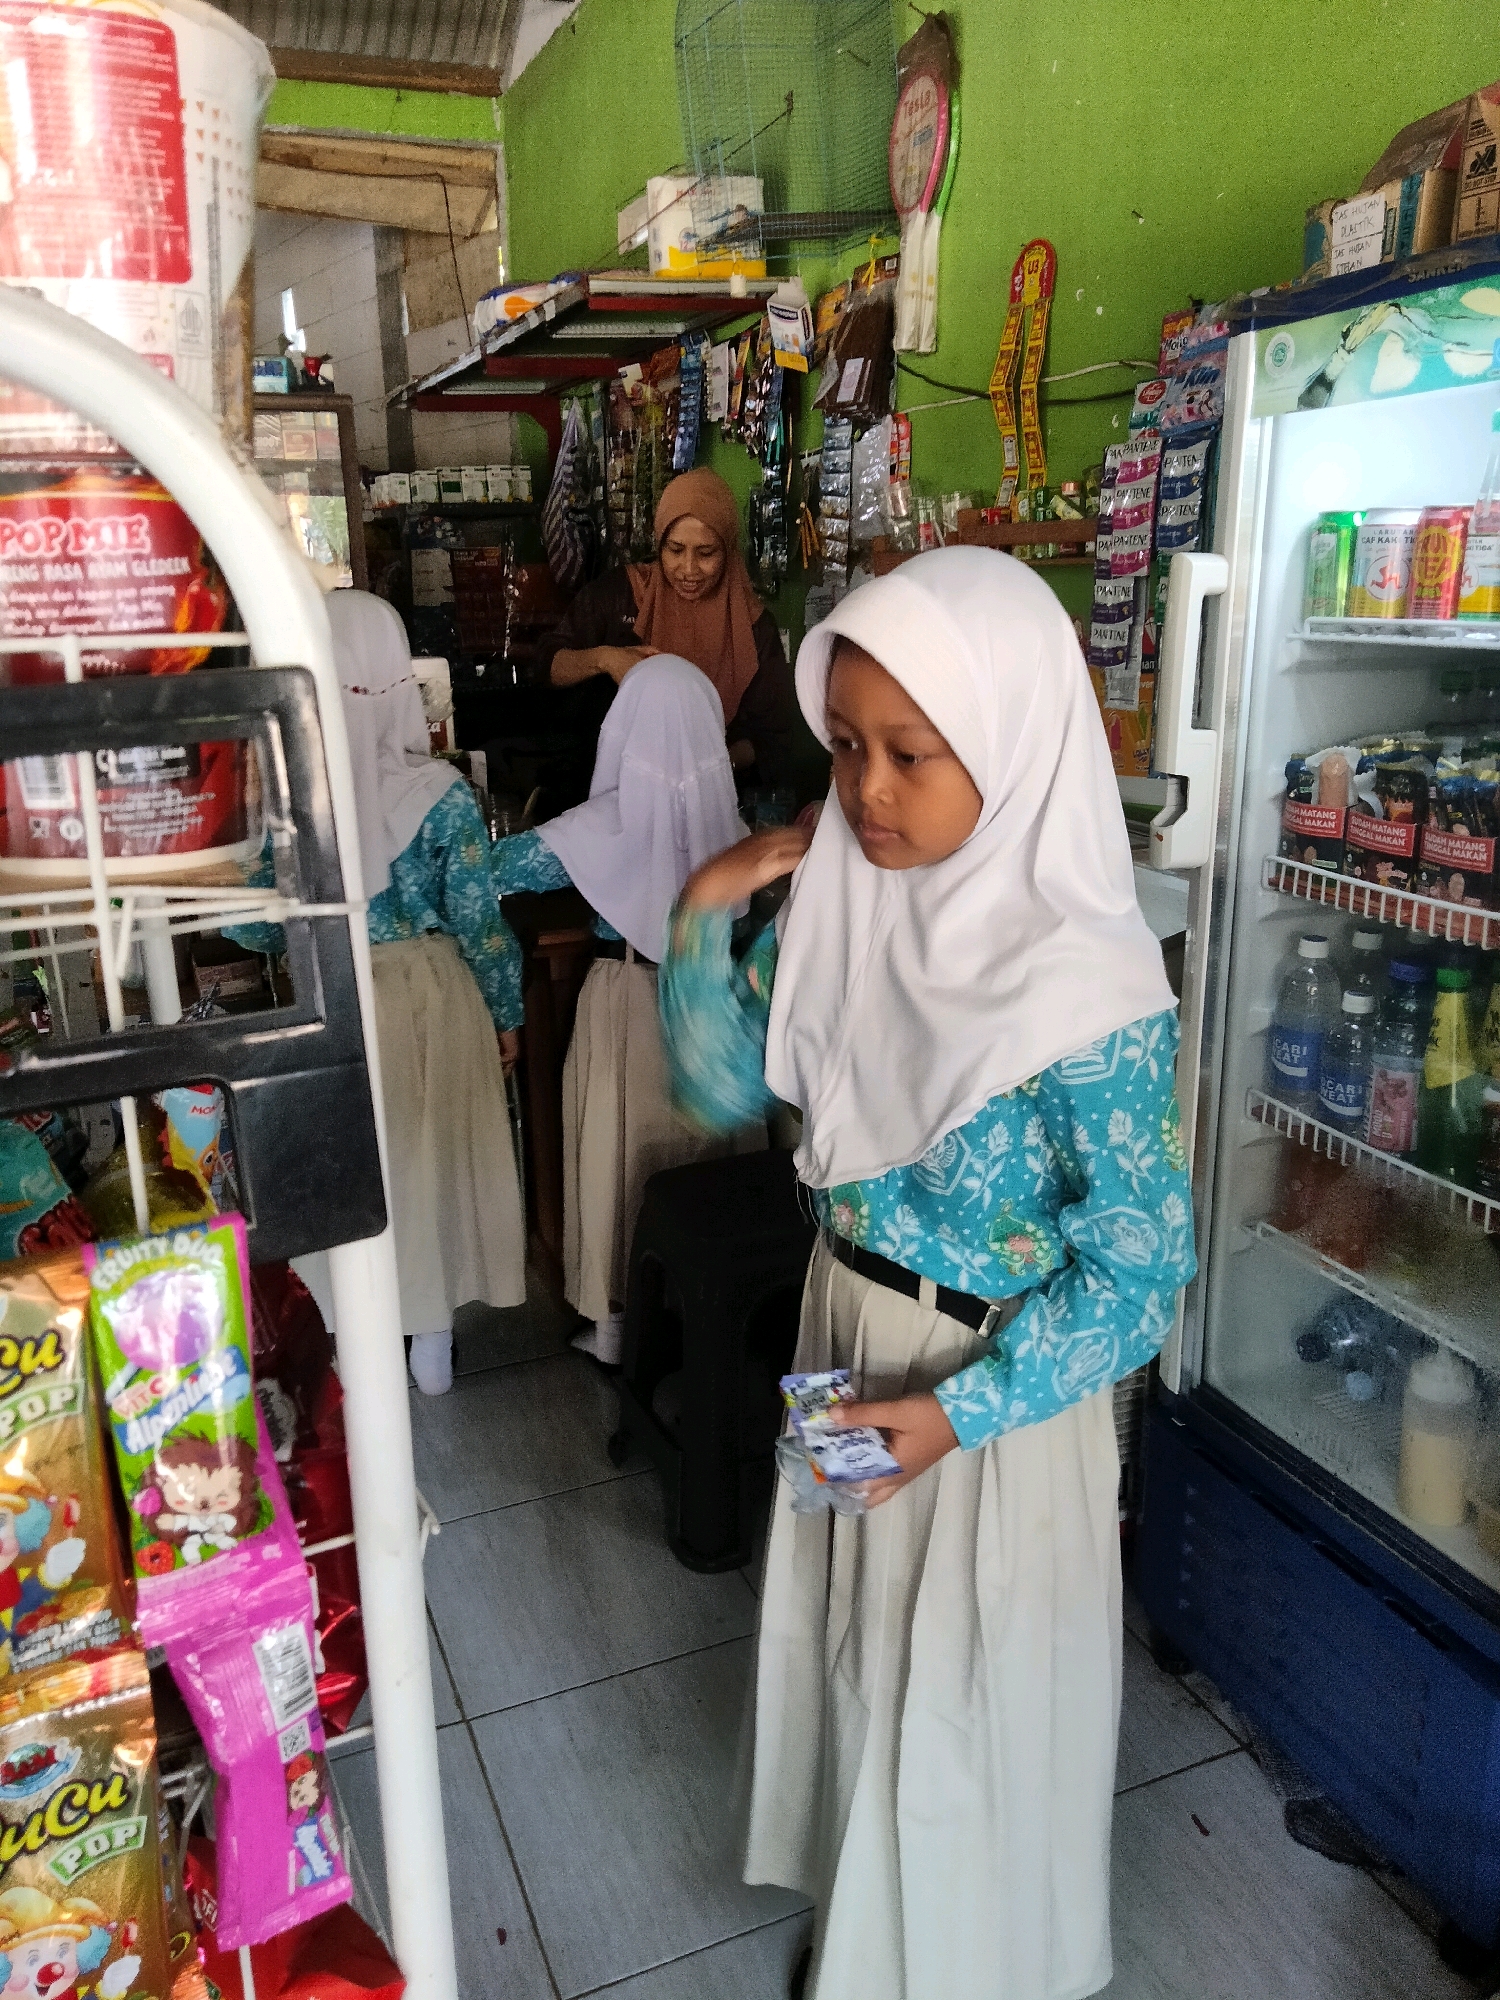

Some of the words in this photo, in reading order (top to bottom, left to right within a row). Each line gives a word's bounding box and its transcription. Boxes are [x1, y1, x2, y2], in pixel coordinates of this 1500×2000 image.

[67, 513, 152, 557] MIE
[1300, 809, 1337, 820] MATANG
[1304, 818, 1336, 829] MAKAN
[1372, 822, 1407, 838] MATANG
[1375, 832, 1406, 847] MAKAN
[1448, 838, 1487, 852] MATANG
[1452, 850, 1488, 862] MAKAN
[91, 1236, 170, 1291] FRUITY
[57, 1823, 138, 1875] POP
